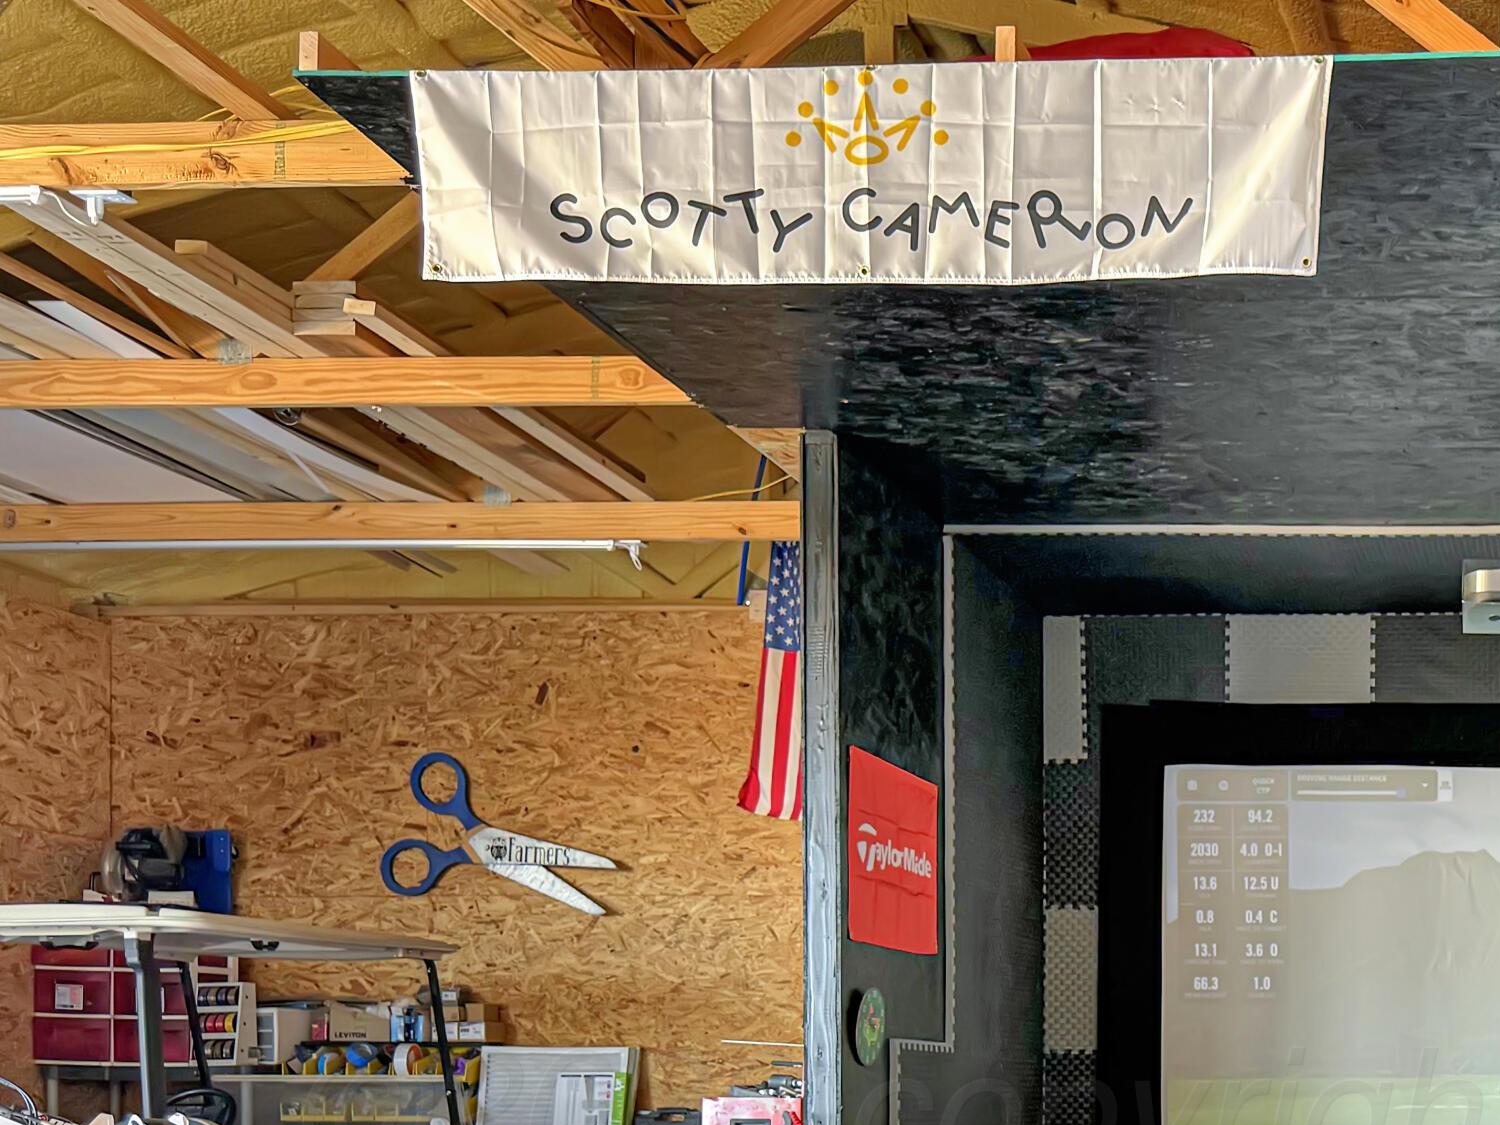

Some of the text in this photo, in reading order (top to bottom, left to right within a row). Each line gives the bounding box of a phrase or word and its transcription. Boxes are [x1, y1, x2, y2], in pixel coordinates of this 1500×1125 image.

[549, 187, 1194, 253] SCOTTY CAMERON
[1193, 809, 1215, 823] 232
[508, 837, 571, 865] Farmers
[1190, 843, 1219, 857] 2030
[1239, 843, 1258, 857] 4.0
[1193, 876, 1217, 890] 13.6
[1243, 876, 1279, 890] 12.5 U
[1245, 909, 1278, 923] 0.4 C
[1194, 943, 1217, 957] 13.1
[1245, 943, 1264, 957] 3.6
[1253, 976, 1271, 990] 1.0
[334, 1031, 367, 1039] LEVITON
